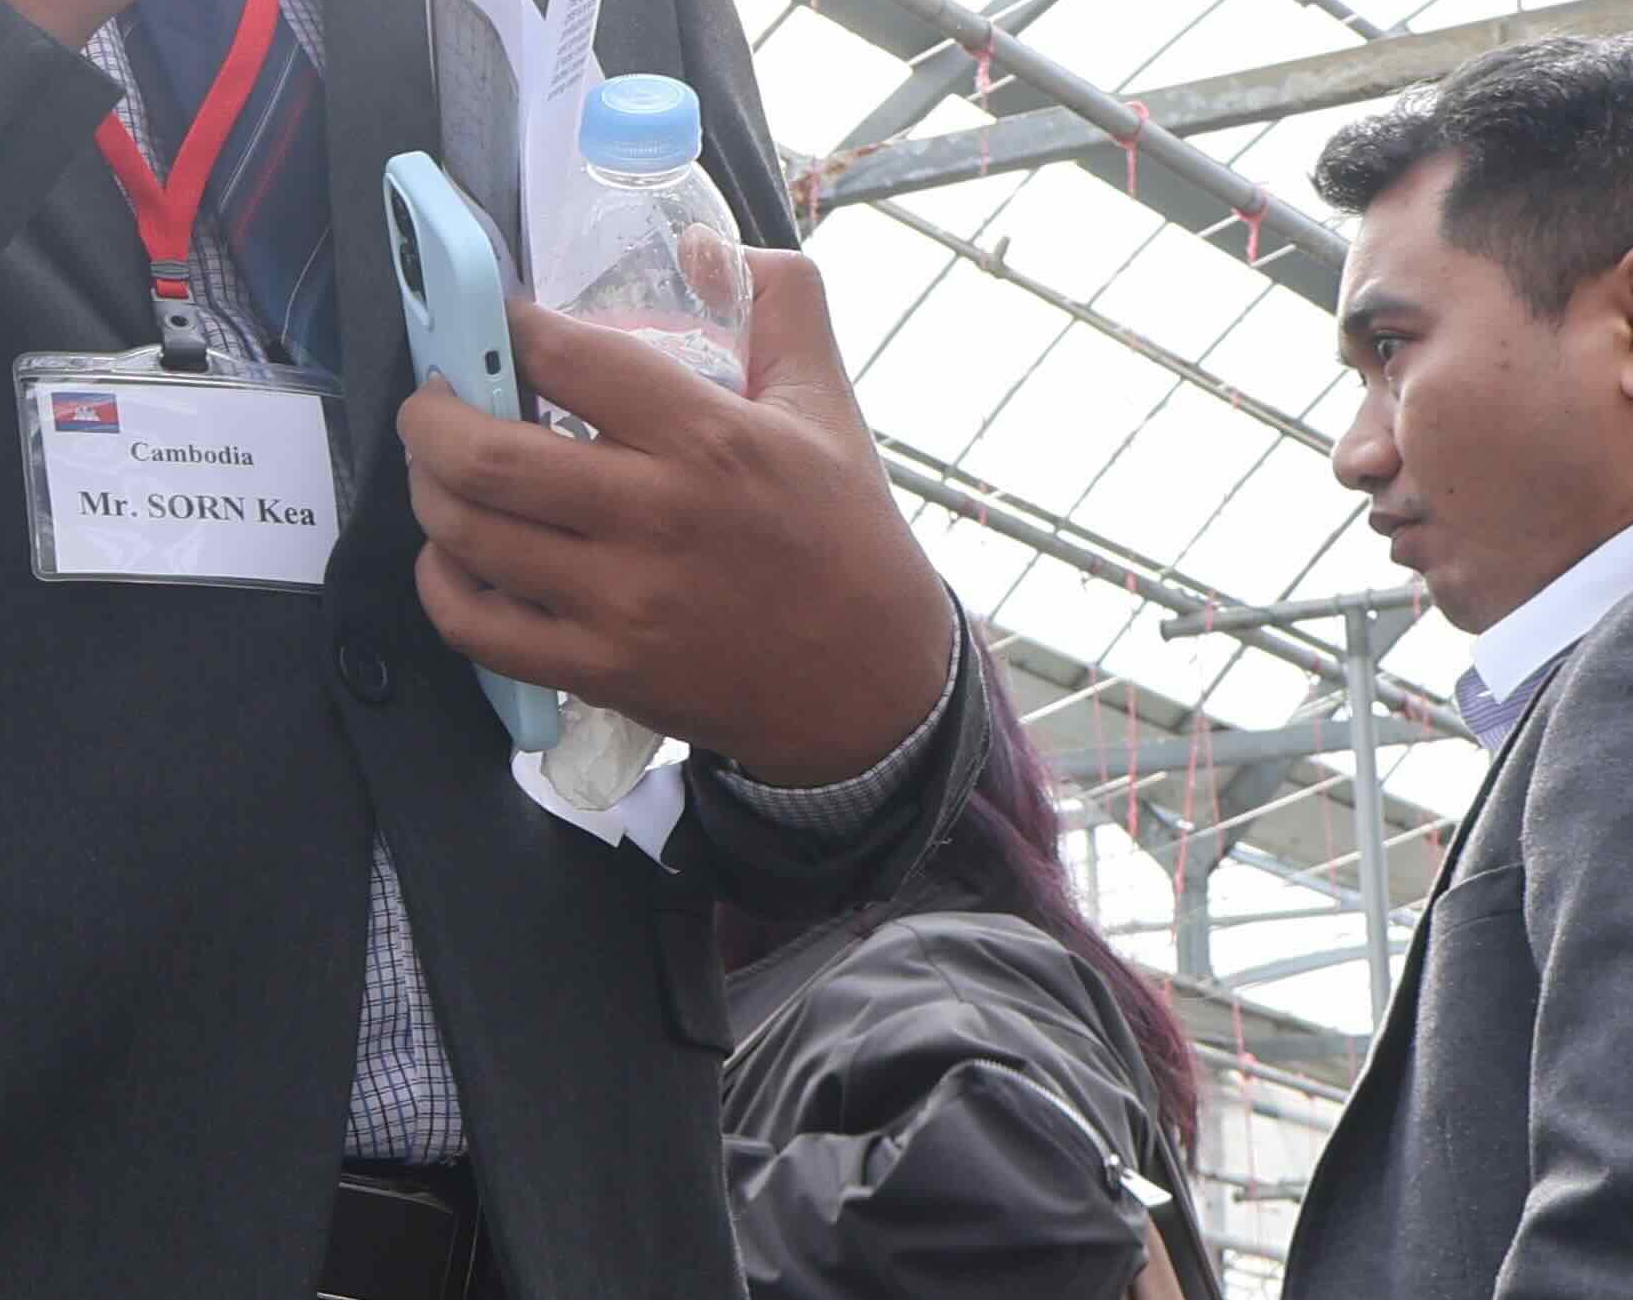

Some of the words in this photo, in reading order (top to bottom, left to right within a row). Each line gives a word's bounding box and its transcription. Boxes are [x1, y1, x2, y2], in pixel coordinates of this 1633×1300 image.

[130, 441, 254, 467] Cambodia
[76, 491, 139, 519] Mr.
[147, 493, 246, 522] SORN
[257, 498, 317, 526] Kea
